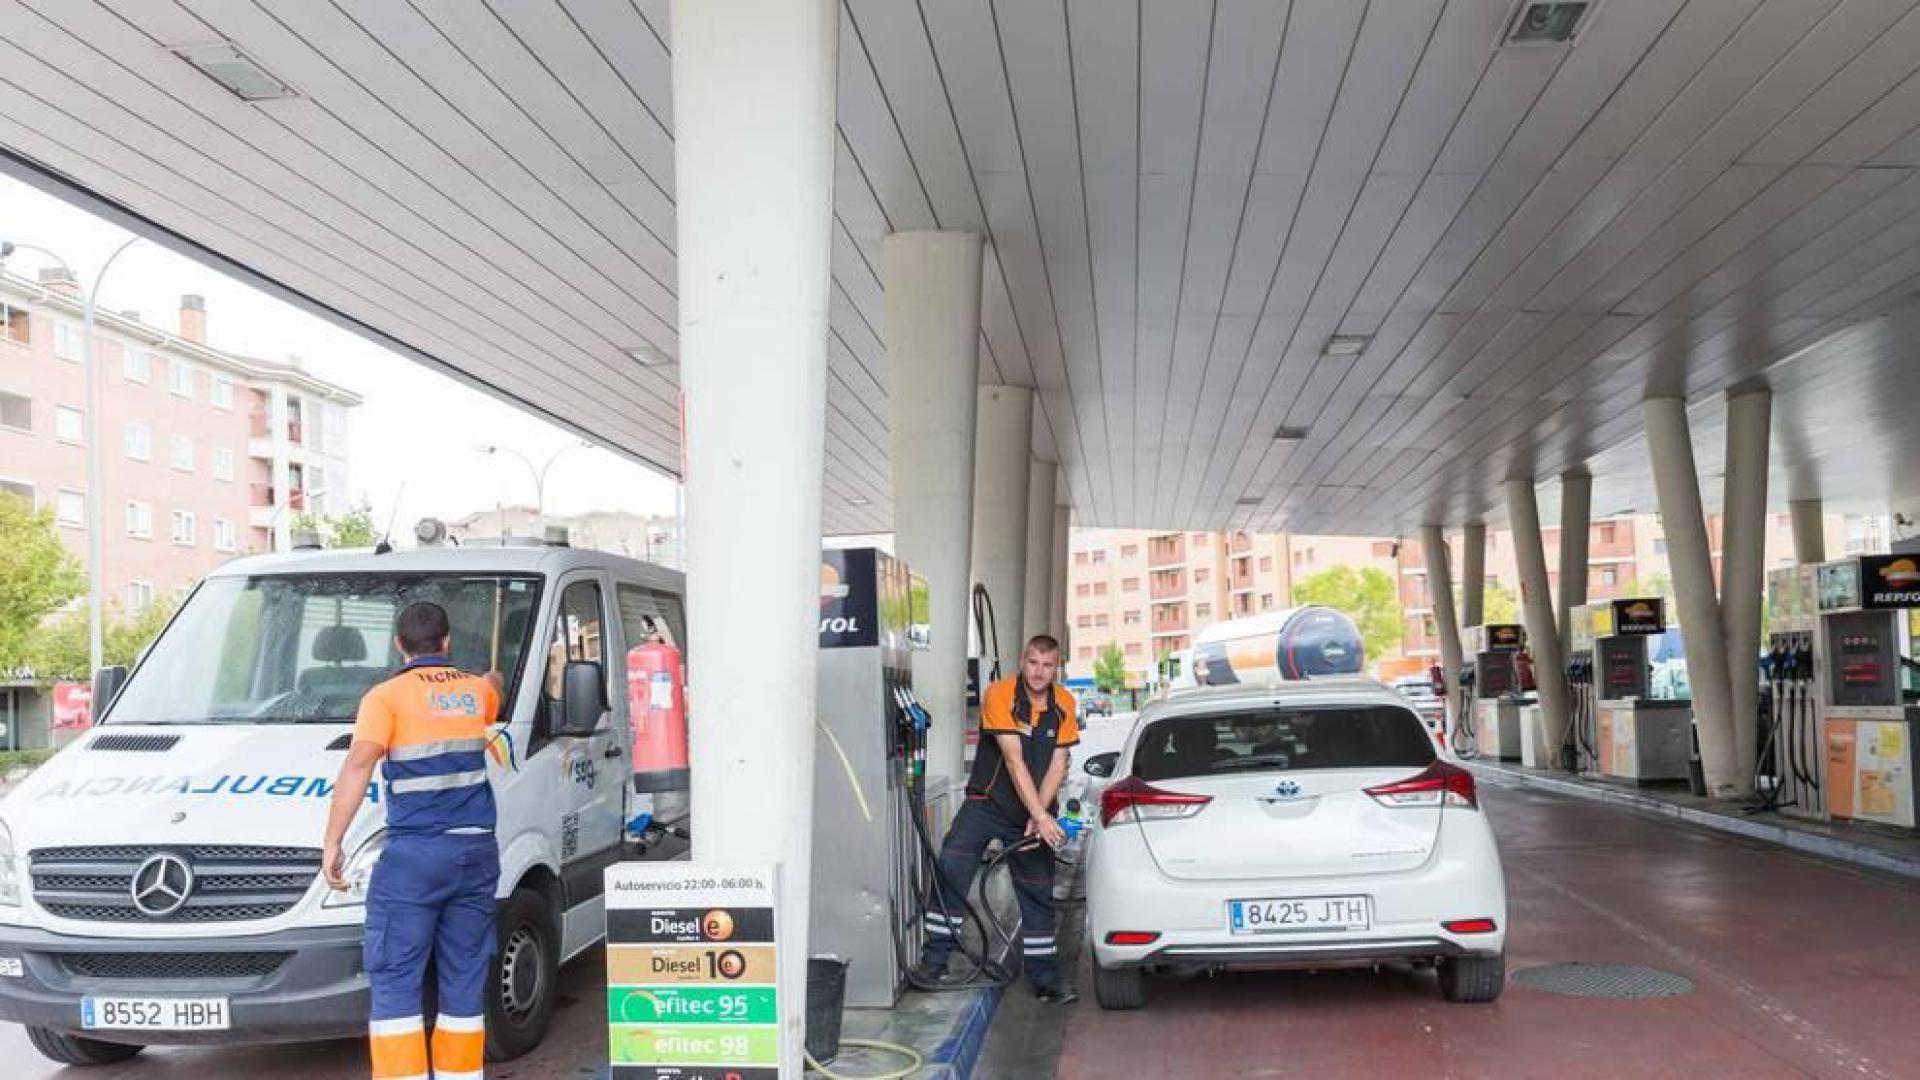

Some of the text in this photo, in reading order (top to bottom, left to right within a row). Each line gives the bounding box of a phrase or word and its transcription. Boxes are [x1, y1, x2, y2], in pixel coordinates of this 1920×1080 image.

[1873, 591, 1920, 602] REPSO
[820, 617, 859, 633] SOL
[614, 879, 683, 891] Autoservicio
[1248, 900, 1362, 925] 8425 JTH
[651, 917, 699, 934] Diesel
[652, 956, 700, 974] Diesel
[103, 1001, 222, 1026] 8552 HBH
[655, 995, 748, 1016] efitec 95
[656, 1036, 749, 1056] efitec 98
